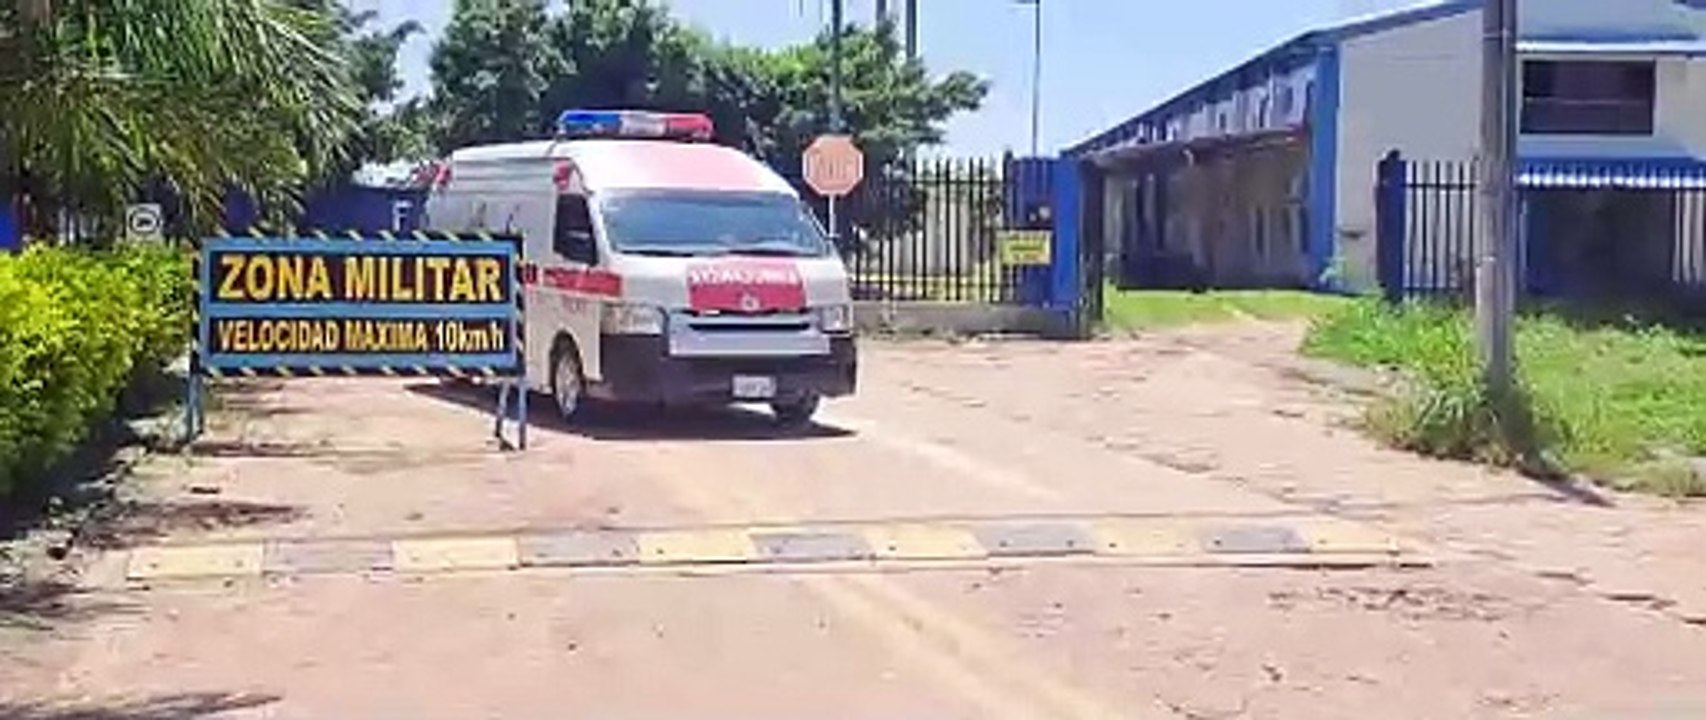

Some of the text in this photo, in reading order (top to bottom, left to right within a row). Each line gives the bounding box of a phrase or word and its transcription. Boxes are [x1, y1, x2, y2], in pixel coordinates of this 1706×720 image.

[218, 255, 502, 301] ZONA MILITAR
[219, 319, 340, 351] VELOCIDAD
[345, 320, 428, 351] MAXIMA
